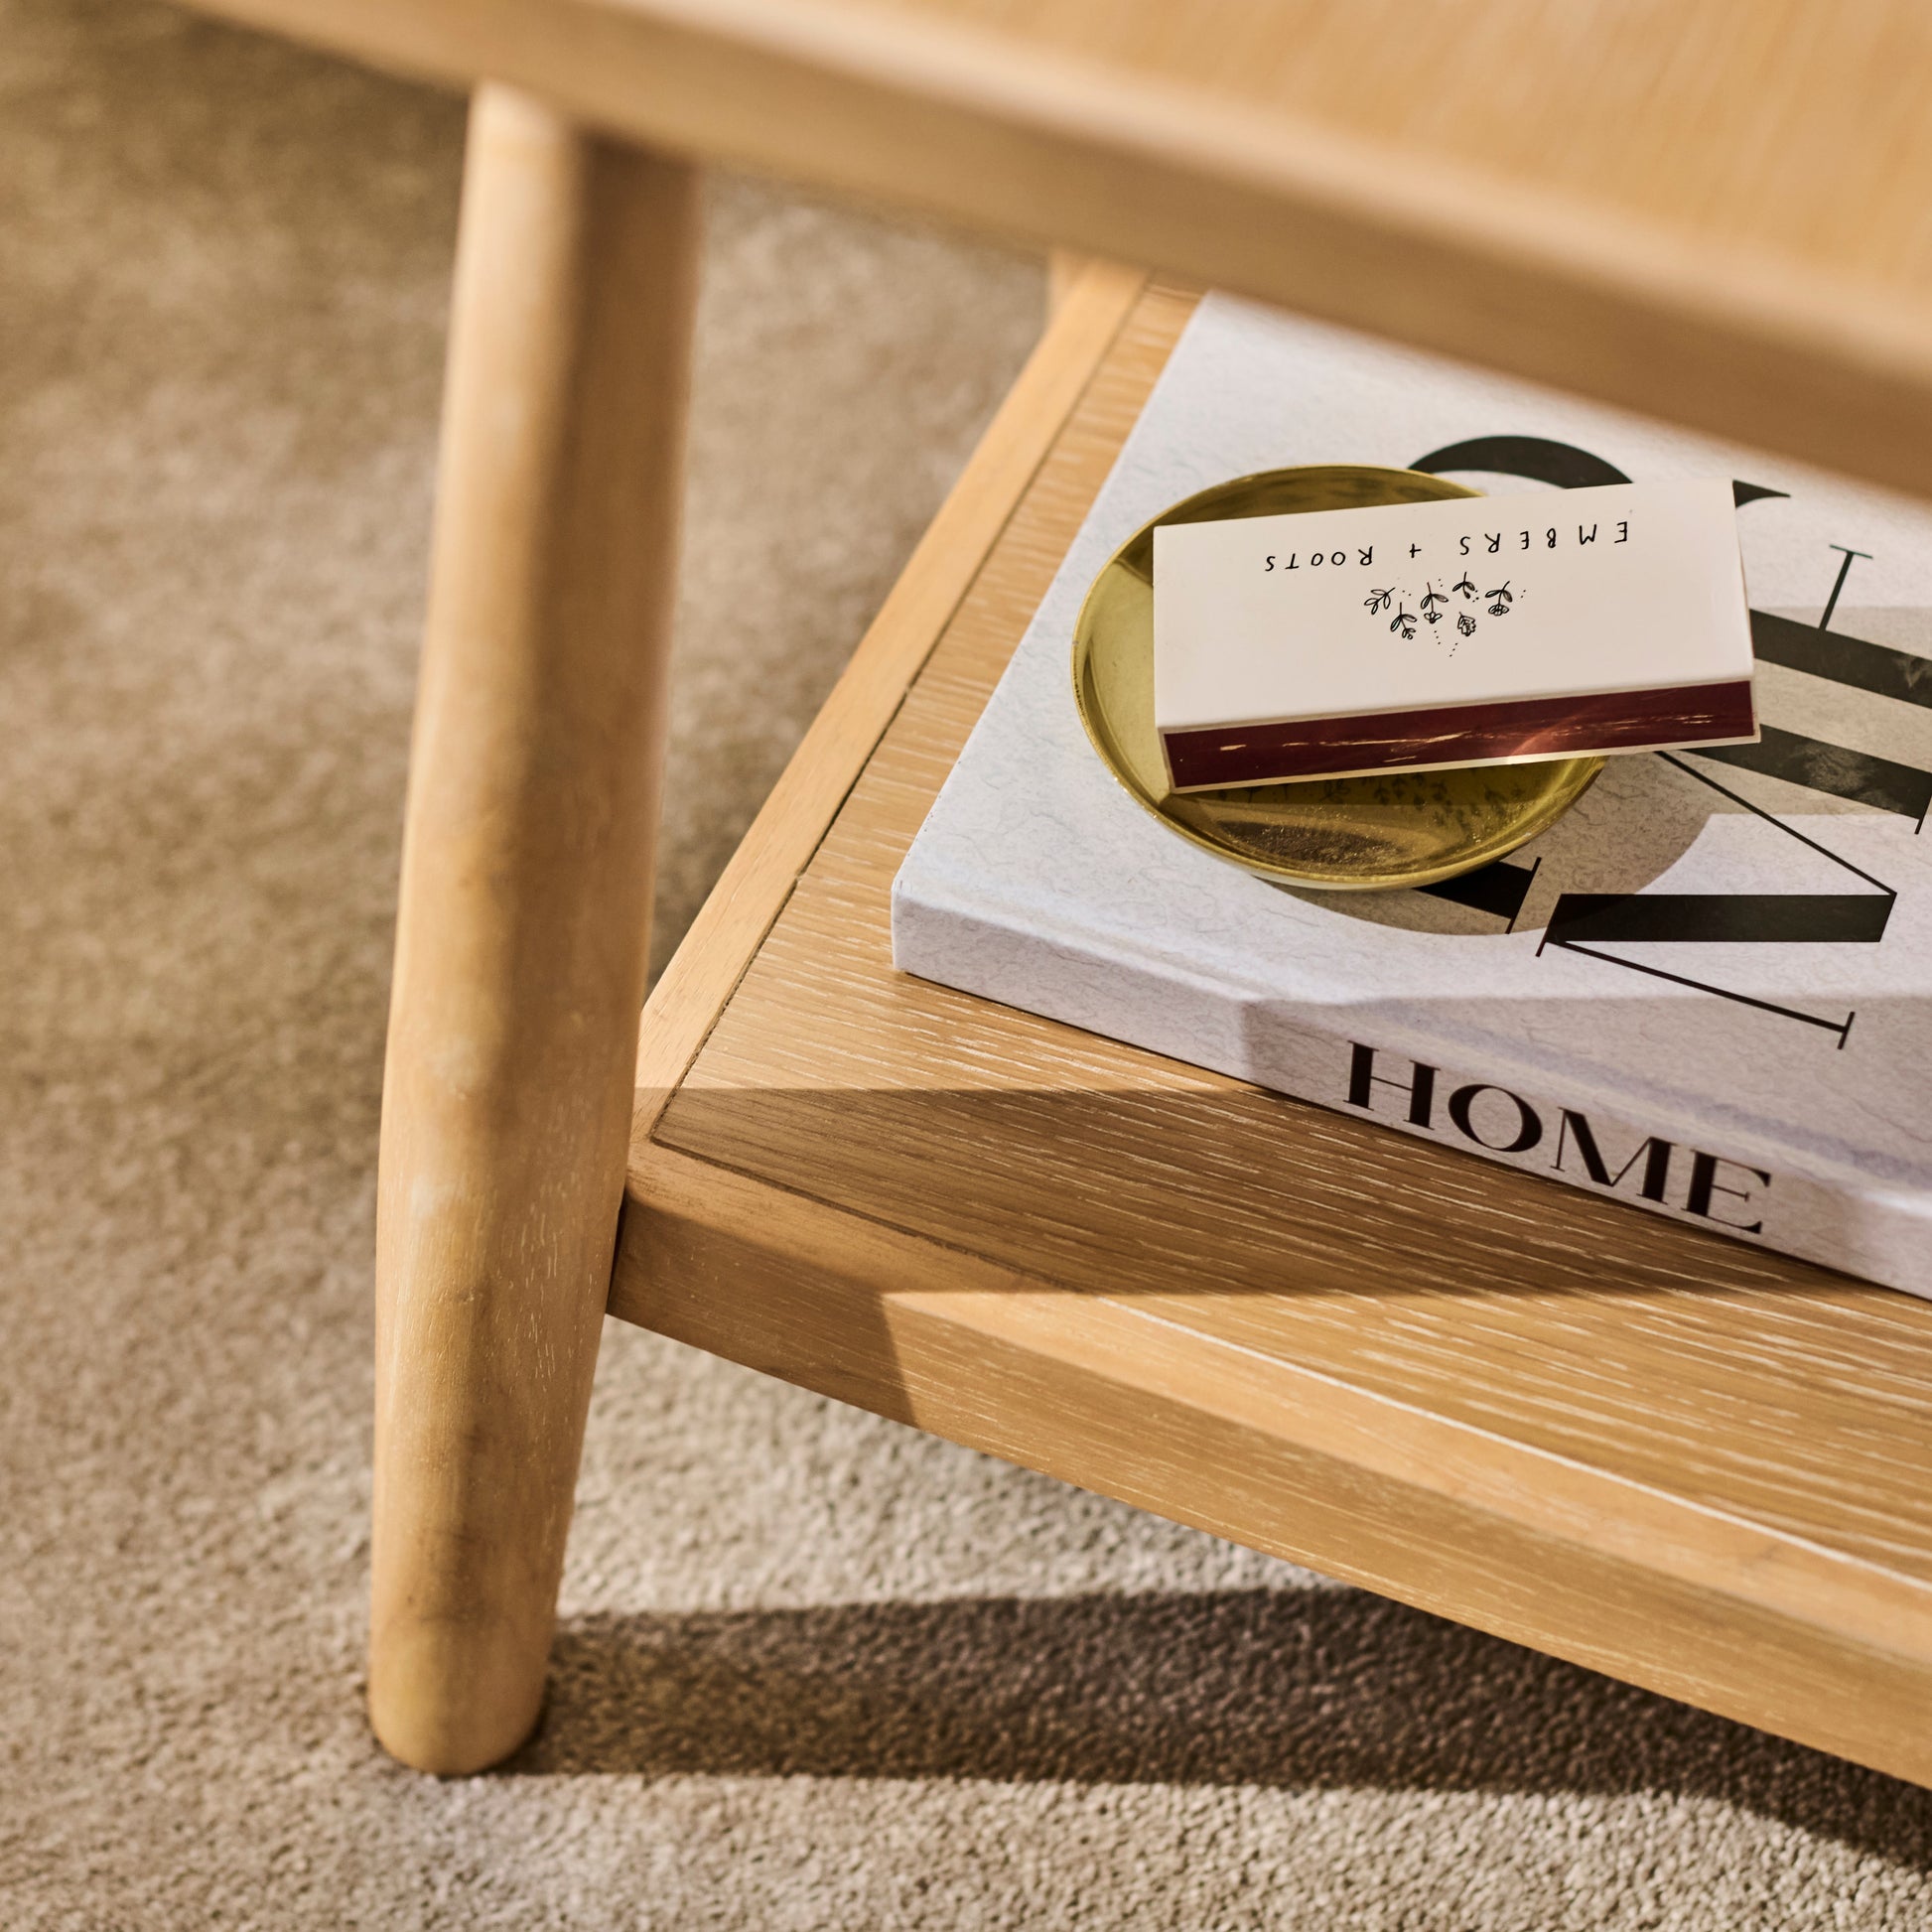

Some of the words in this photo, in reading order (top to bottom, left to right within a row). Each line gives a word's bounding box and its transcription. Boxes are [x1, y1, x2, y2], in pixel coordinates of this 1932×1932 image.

[1409, 543, 1422, 559] +
[1459, 520, 1628, 556] EMBERS
[1264, 545, 1374, 572] ROOTS
[1343, 1039, 1771, 1234] HOME
